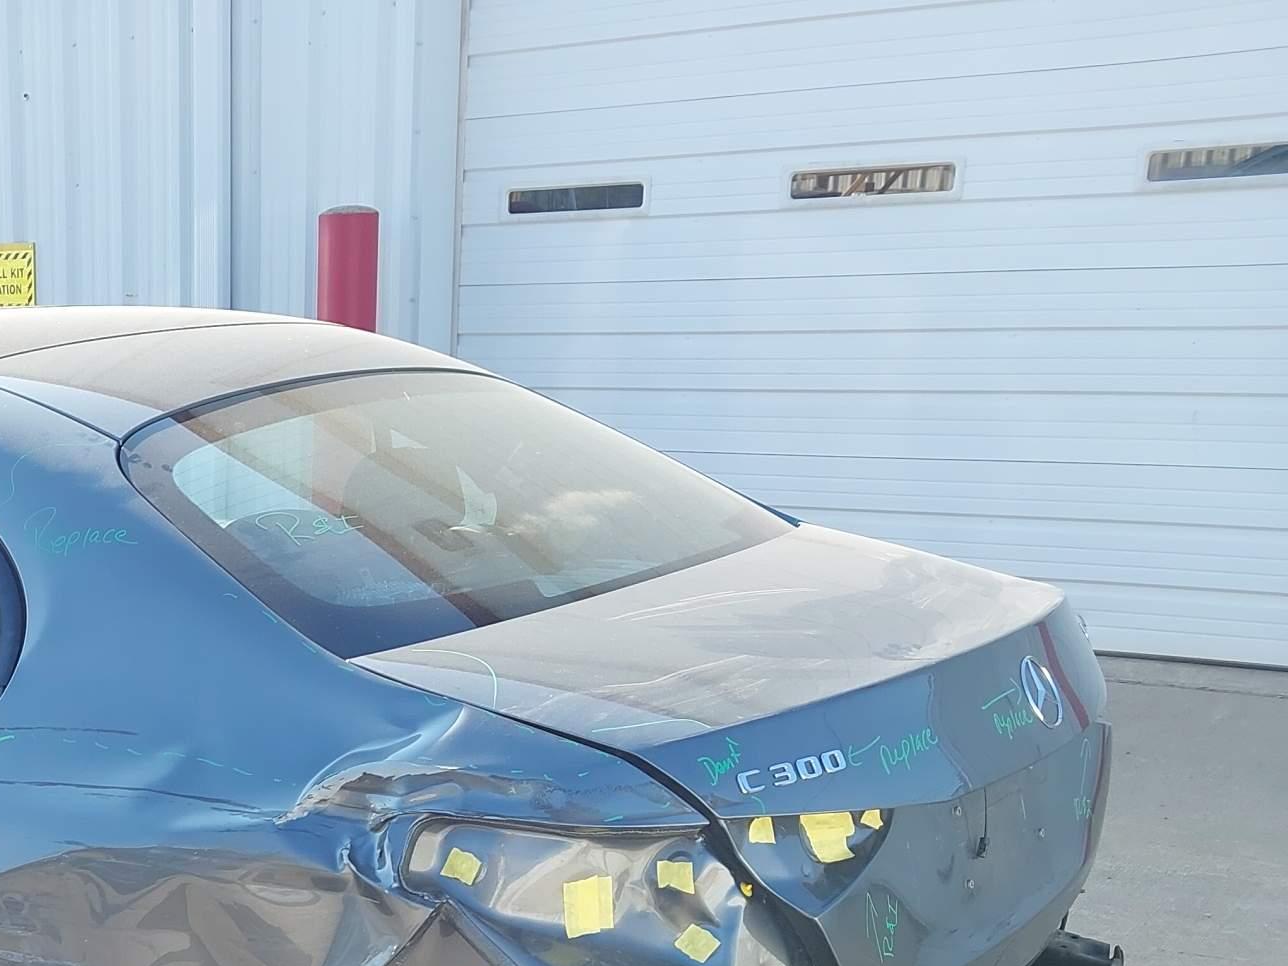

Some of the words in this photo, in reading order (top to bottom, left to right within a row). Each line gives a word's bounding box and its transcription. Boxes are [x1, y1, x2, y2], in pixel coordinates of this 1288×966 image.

[10, 267, 25, 279] KIT
[23, 505, 139, 557] Replace
[736, 768, 767, 796] C
[768, 748, 848, 788] 300
